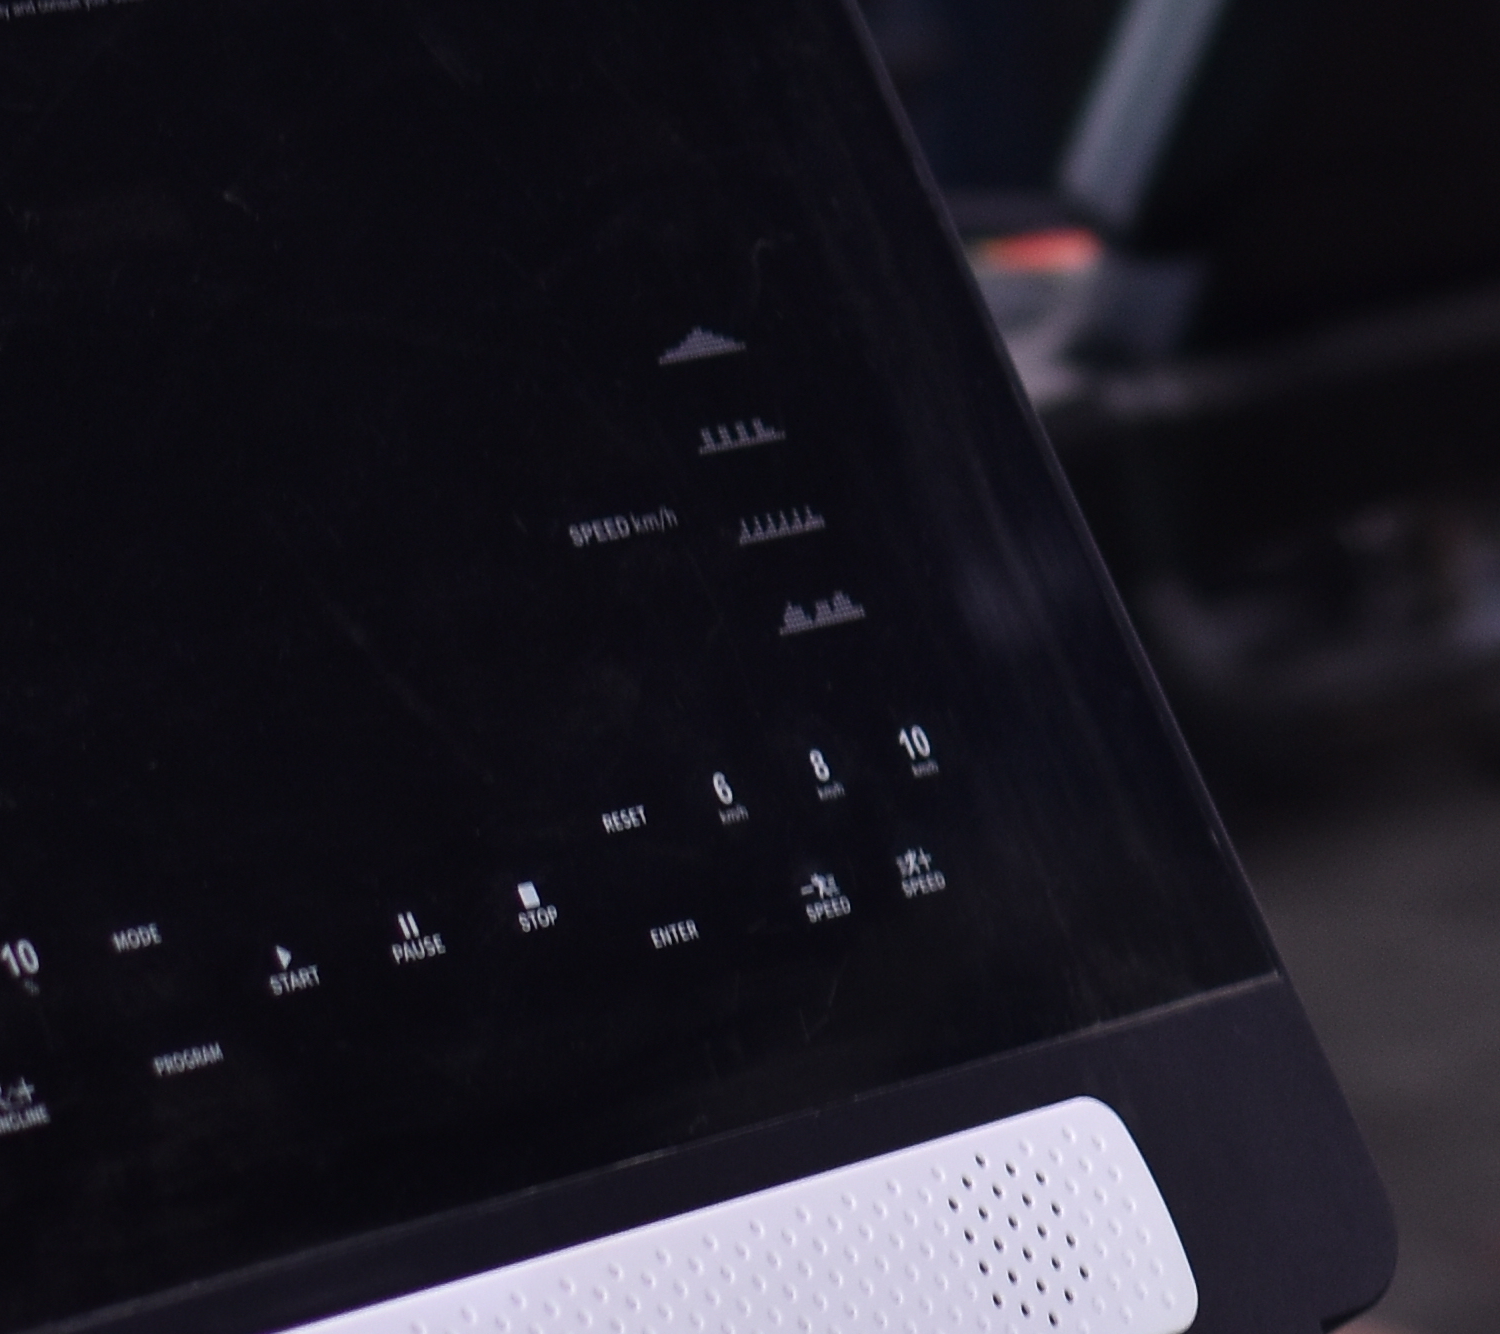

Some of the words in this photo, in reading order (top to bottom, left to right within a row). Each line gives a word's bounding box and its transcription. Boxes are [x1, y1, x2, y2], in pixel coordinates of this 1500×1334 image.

[568, 515, 631, 548] SPEED
[631, 505, 679, 535] km/h
[899, 724, 932, 760] 10
[809, 748, 831, 783] 8
[712, 770, 734, 805] 6
[602, 804, 648, 835] RESET
[902, 871, 947, 899] SPEED
[518, 906, 559, 934] STOP
[806, 895, 852, 925] SPEED
[111, 923, 163, 953] MODE
[391, 933, 447, 965] PAUSE
[650, 919, 701, 950] ENTER
[0, 939, 40, 977] 10
[269, 964, 321, 997] START
[153, 1042, 225, 1077] PROGRAM
